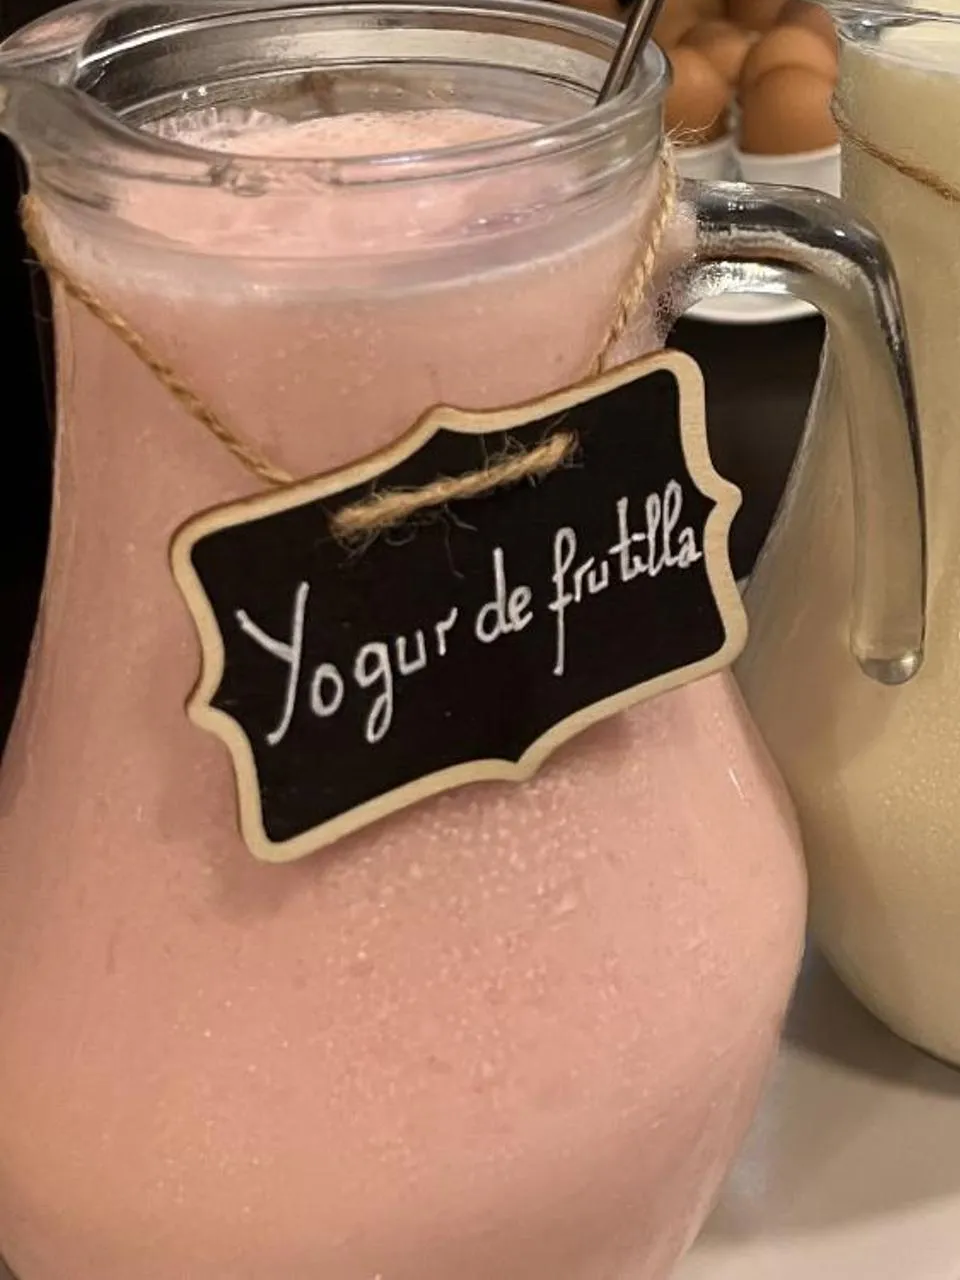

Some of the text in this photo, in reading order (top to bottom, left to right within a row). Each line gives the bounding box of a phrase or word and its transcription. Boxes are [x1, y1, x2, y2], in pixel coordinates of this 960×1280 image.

[235, 478, 703, 747] Yogur de frutilla
